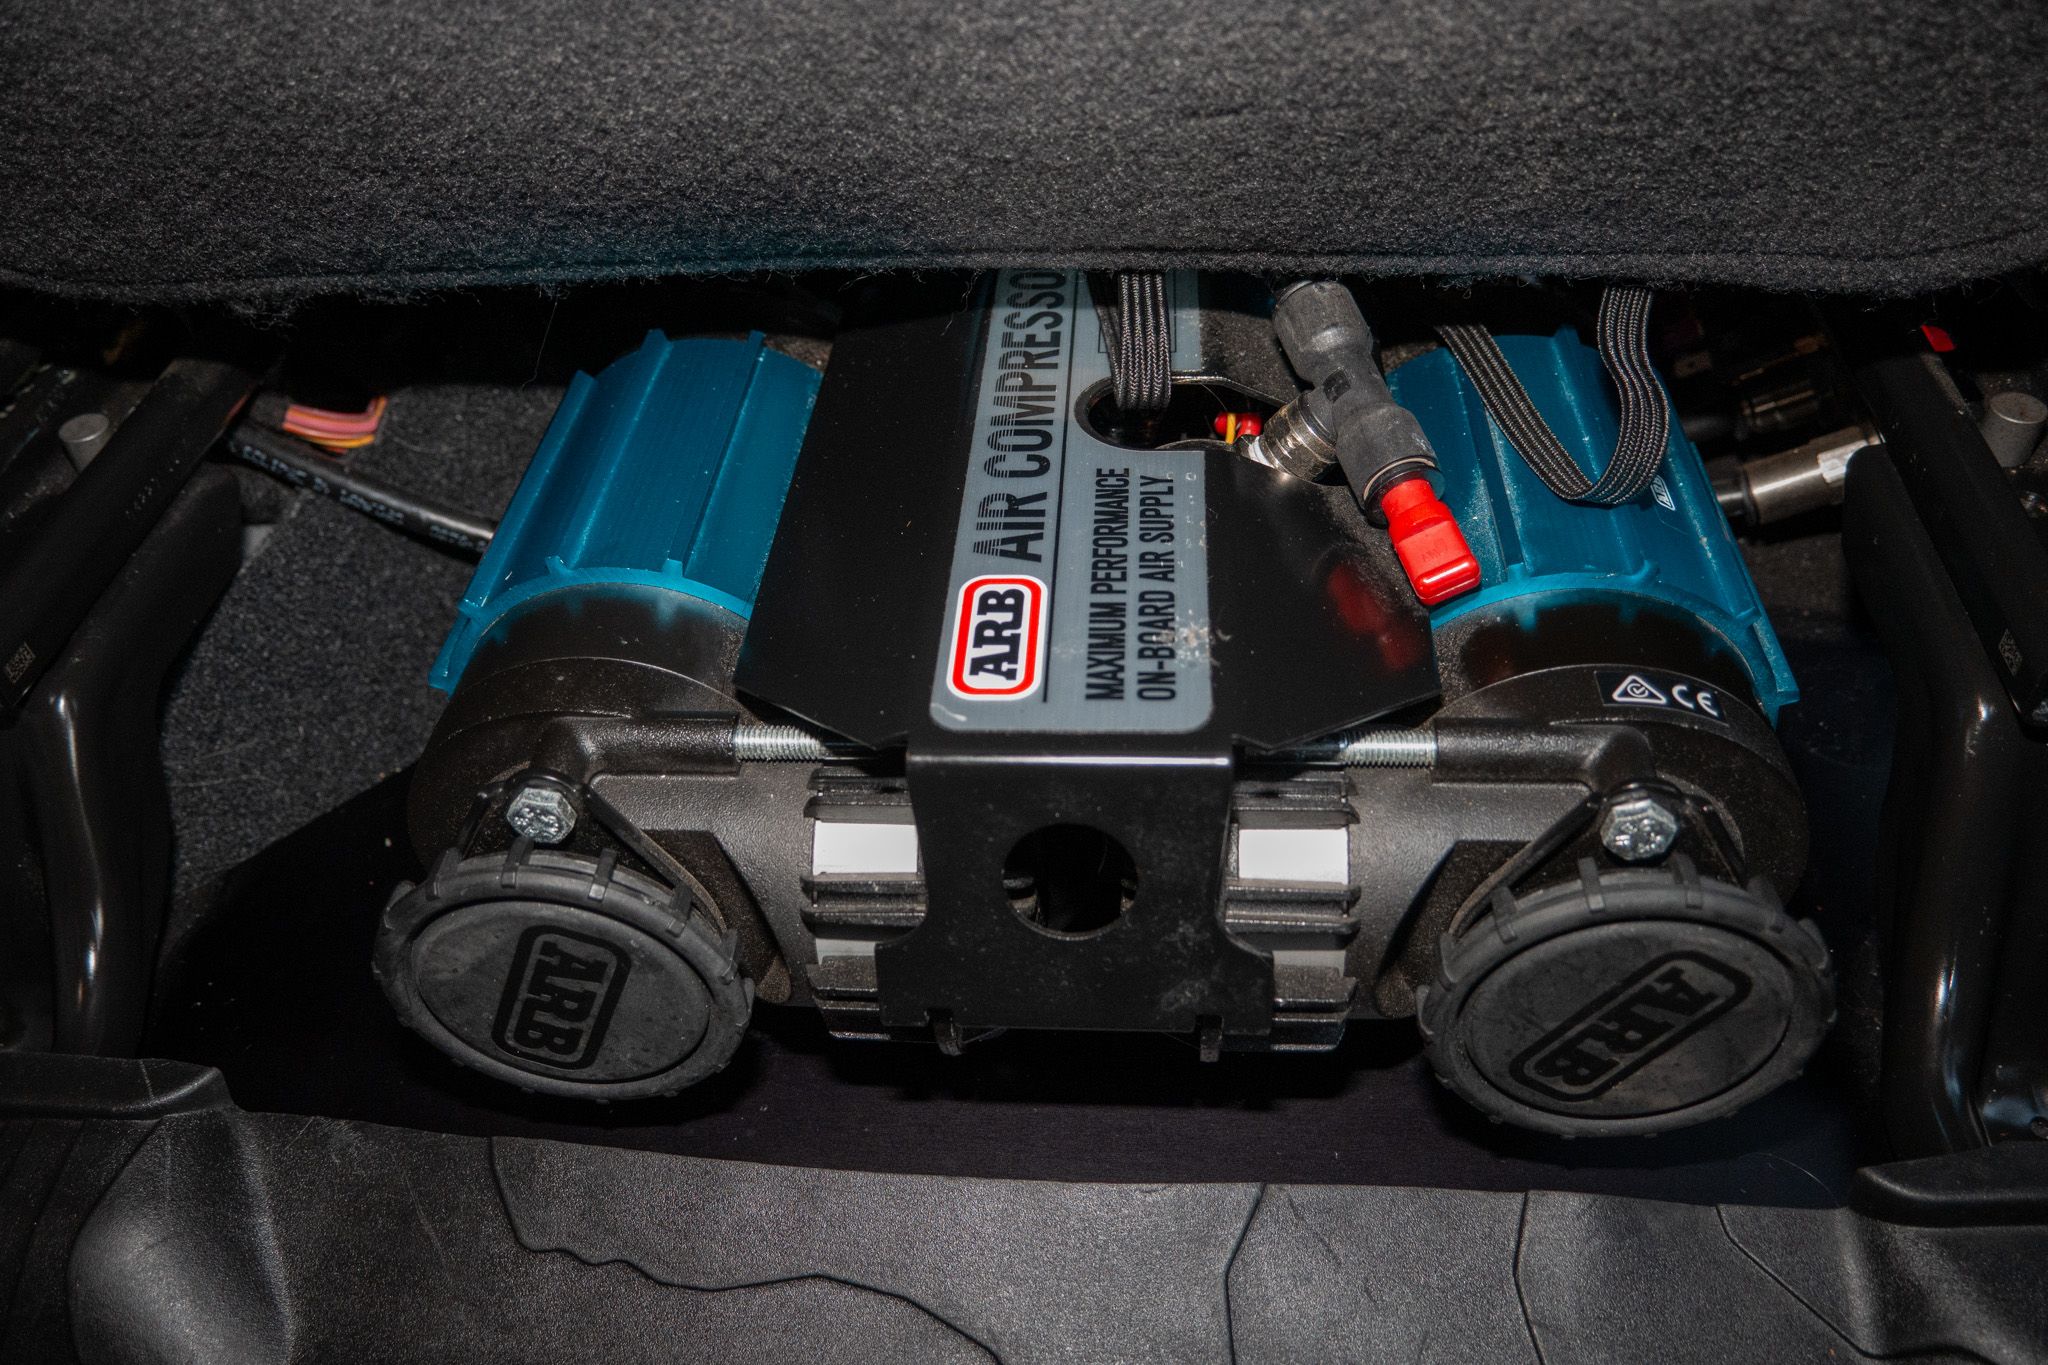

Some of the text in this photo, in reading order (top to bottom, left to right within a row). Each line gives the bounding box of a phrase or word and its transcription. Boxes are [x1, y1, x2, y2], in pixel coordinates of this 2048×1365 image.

[973, 270, 1067, 563] AIR COMPRESSO
[970, 588, 1026, 681] ARB
[1085, 467, 1130, 701] MAXIMUM PERFORMANCE
[1137, 474, 1177, 701] ON-BOARD AIR SUPPLY
[512, 940, 609, 1056] ARB
[1533, 966, 1719, 1087] ARB
